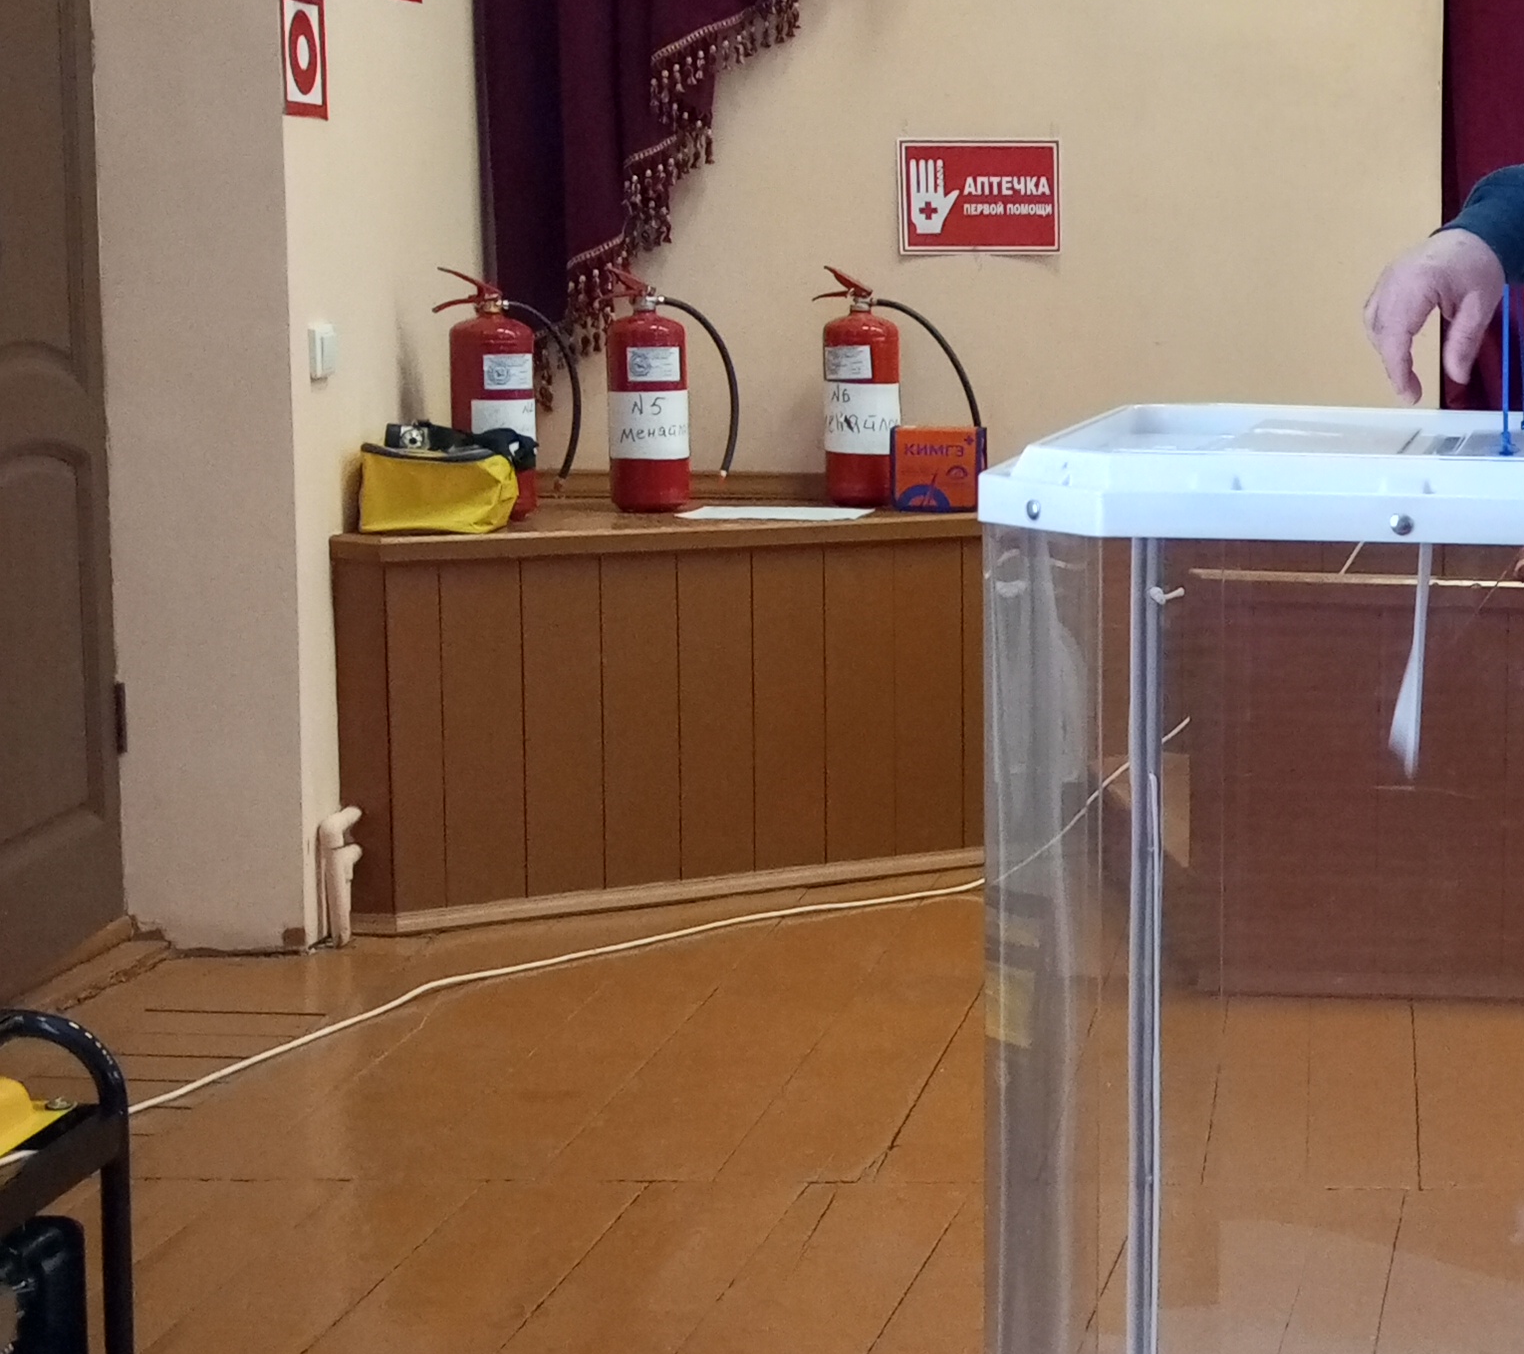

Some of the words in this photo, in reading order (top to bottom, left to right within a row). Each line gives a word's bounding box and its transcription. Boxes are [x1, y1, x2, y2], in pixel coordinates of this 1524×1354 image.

[963, 176, 1051, 196] АПТЕЧКА
[963, 201, 1004, 216] ПЕРВОЙ
[1006, 203, 1053, 218] ПОМОЩИ
